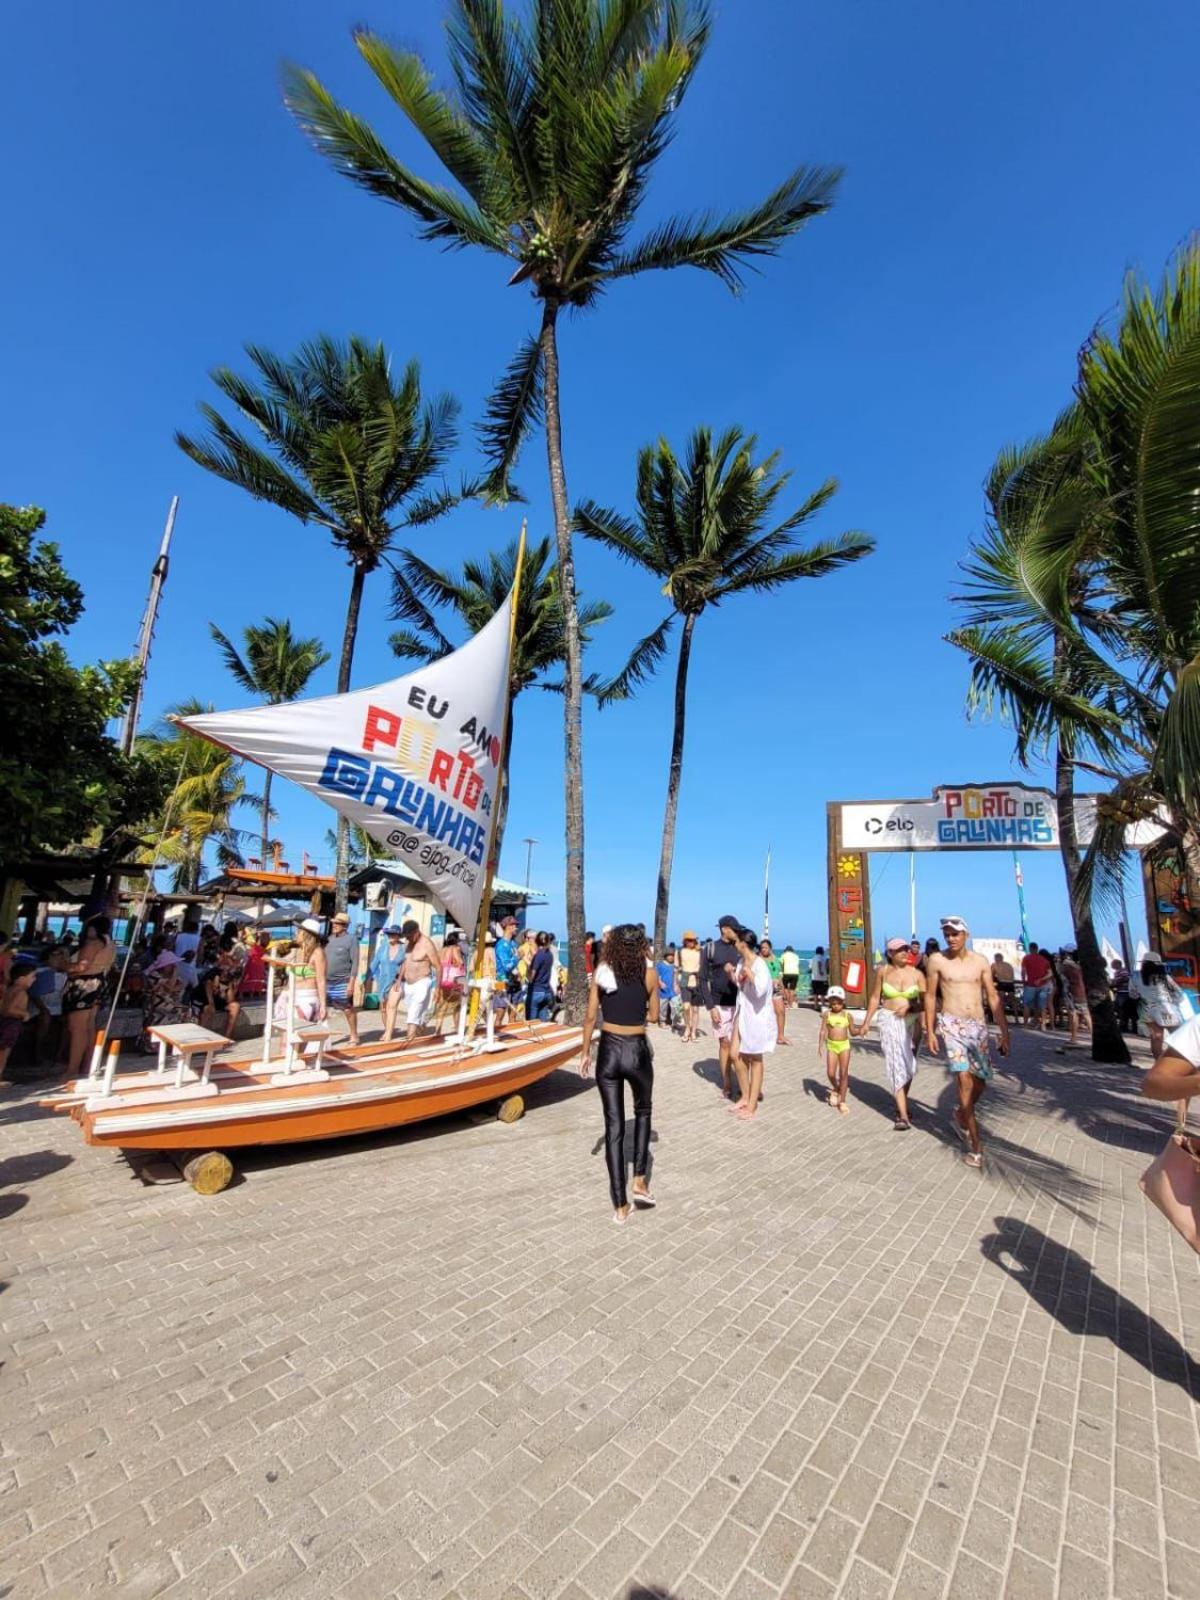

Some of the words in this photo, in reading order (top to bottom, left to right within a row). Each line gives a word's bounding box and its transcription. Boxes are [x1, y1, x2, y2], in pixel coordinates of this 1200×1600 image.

[408, 685, 449, 719] EU
[362, 704, 485, 811] PORTO
[481, 791, 493, 816] DE
[318, 746, 485, 866] GALINHAS
[944, 789, 1018, 819] PORTO
[1023, 801, 1045, 817] DE
[937, 819, 1053, 843] GALINHAS
